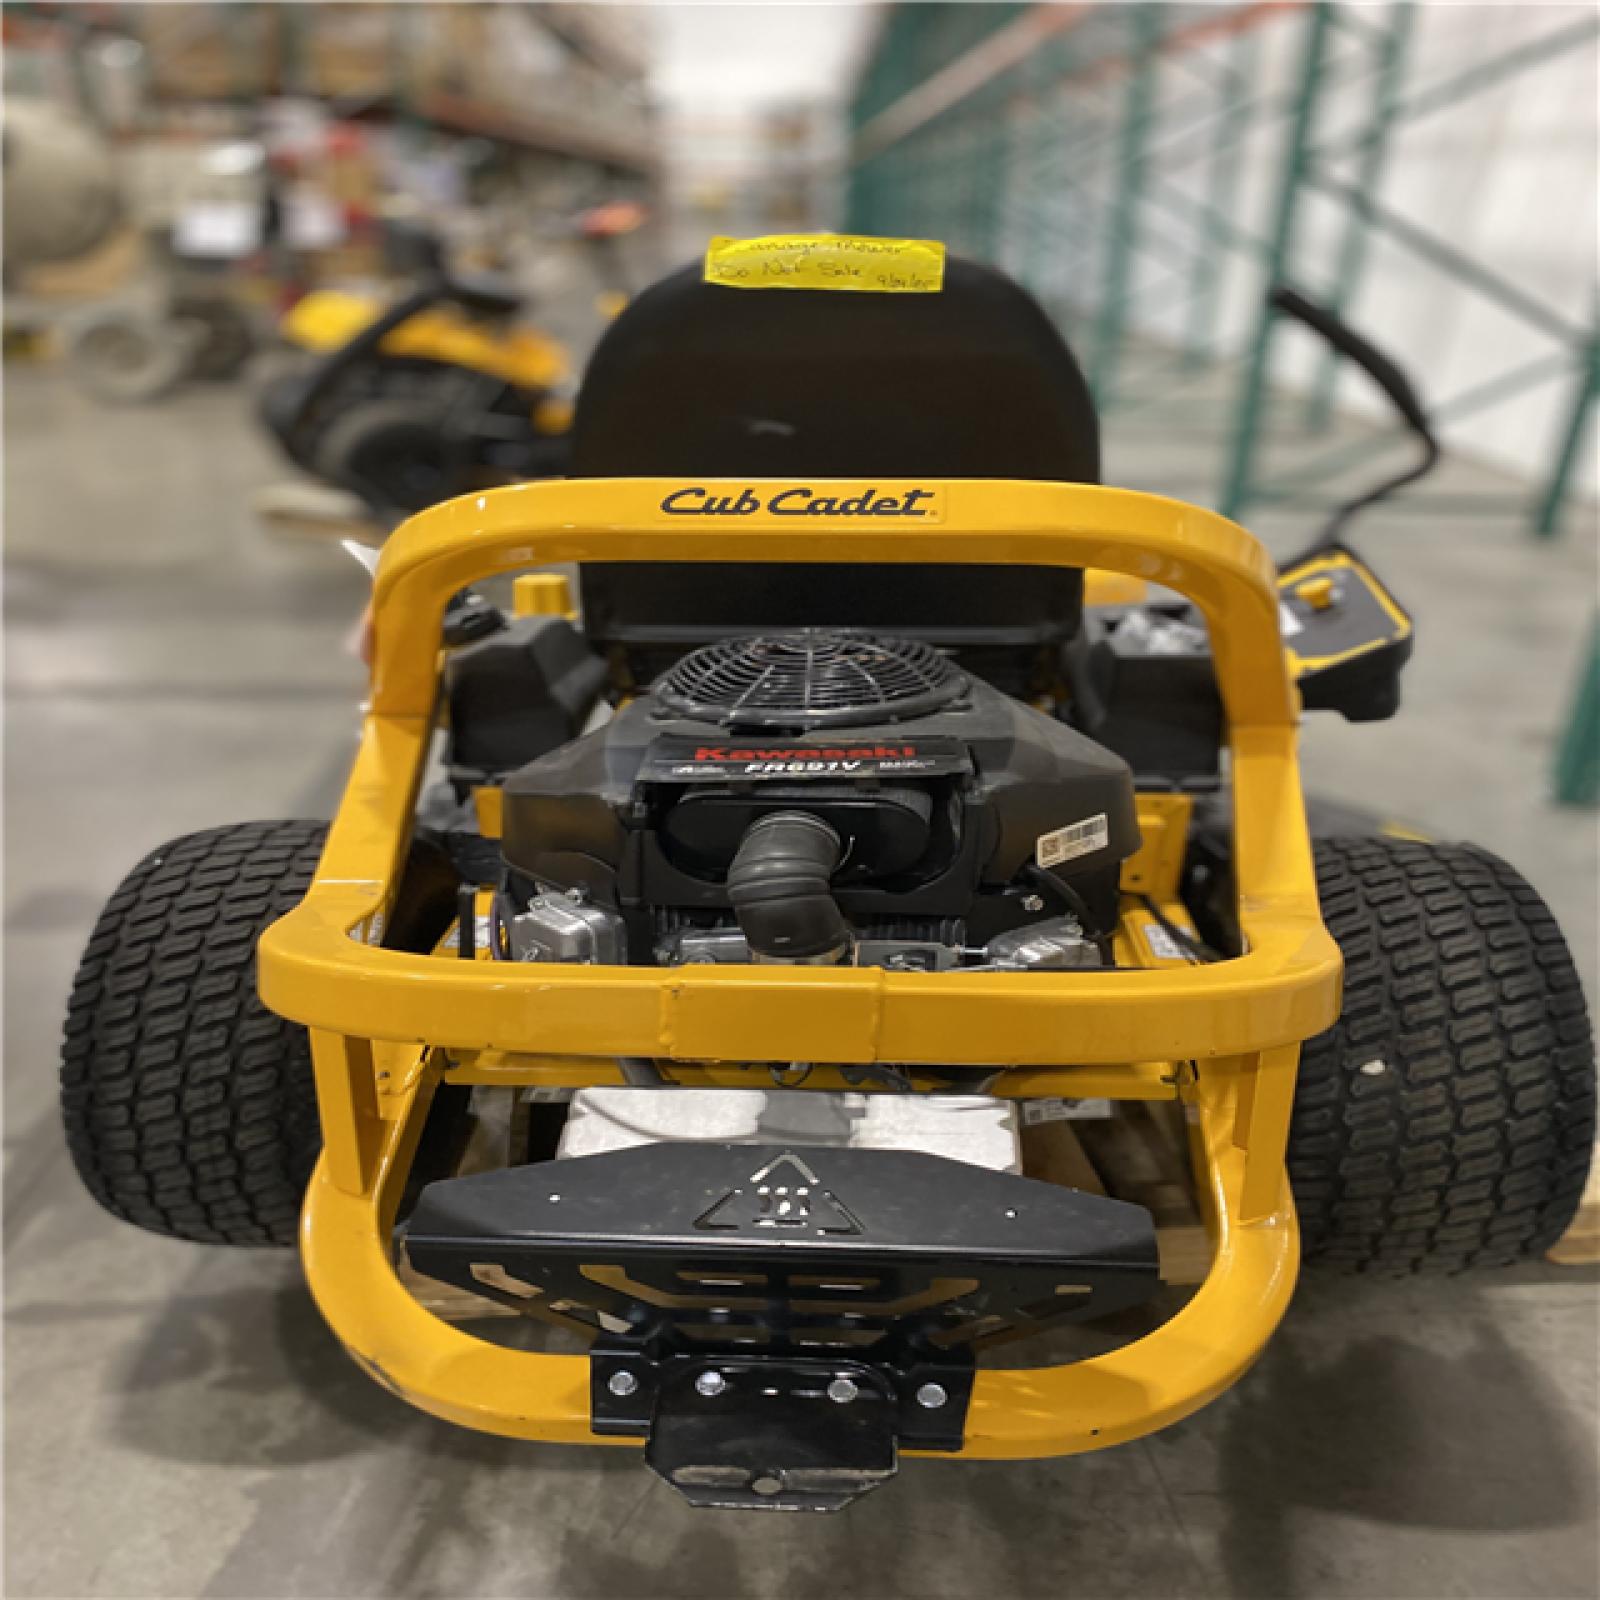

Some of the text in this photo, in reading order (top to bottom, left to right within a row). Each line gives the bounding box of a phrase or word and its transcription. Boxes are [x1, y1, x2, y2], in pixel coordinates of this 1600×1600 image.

[660, 488, 935, 515] Cub Cadet
[694, 746, 916, 760] Kawasaki
